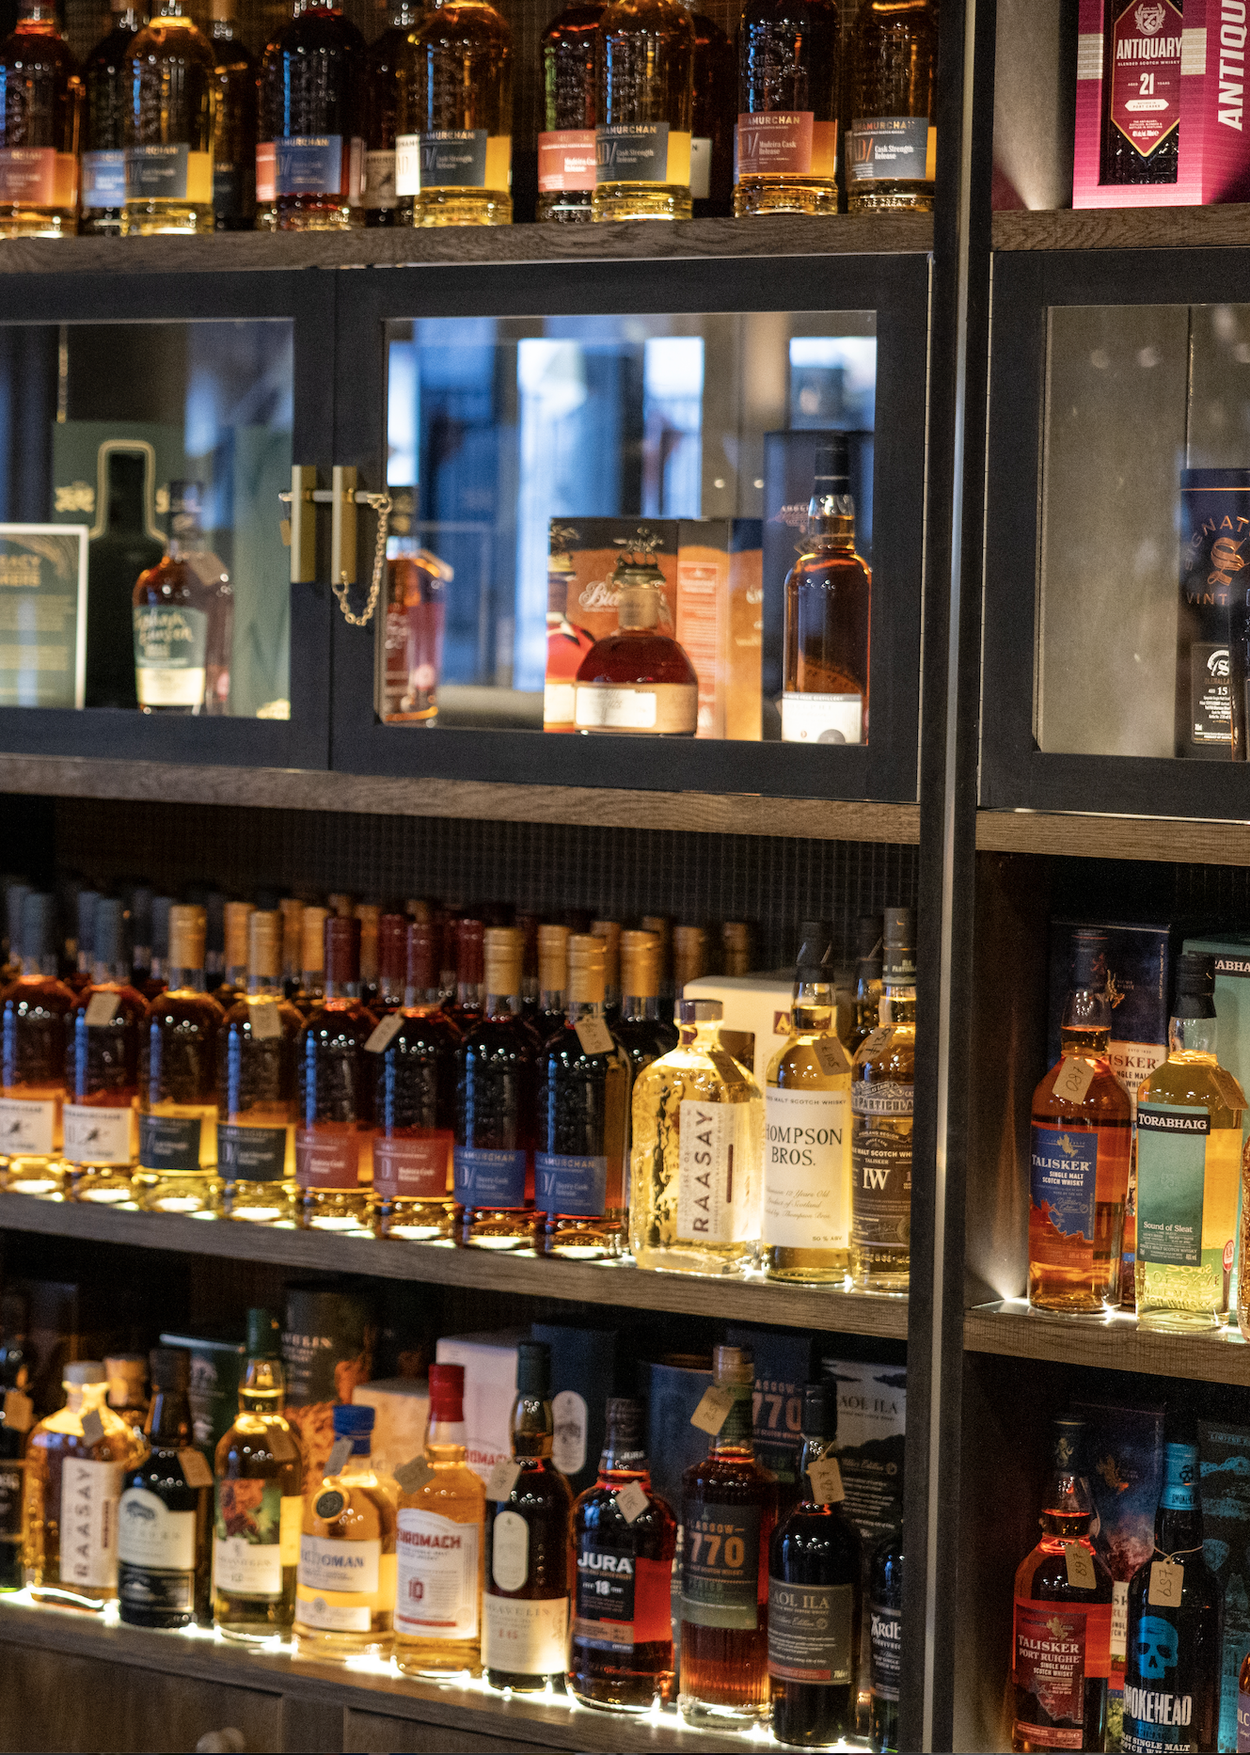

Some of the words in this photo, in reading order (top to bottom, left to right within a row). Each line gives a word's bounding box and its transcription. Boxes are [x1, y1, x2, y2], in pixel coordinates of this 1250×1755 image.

[1116, 37, 1182, 60] ANTIQUARY
[1217, 0, 1248, 132] ANTIQU
[1139, 73, 1154, 95] 21
[874, 144, 886, 153] Cask
[887, 145, 914, 155] Strength
[1184, 514, 1250, 571] SIGNAT
[1186, 591, 1228, 606] VINT
[1217, 686, 1228, 695] 15
[858, 1096, 914, 1112] PARTICULA
[1137, 1112, 1208, 1131] TORABHAIG
[771, 1146, 816, 1167] BROS.
[871, 1150, 897, 1158] SCOTCH
[1032, 1154, 1088, 1172] TALISKER
[692, 1110, 713, 1233] RAASAY
[1049, 1170, 1067, 1179] SINGLE
[1042, 1177, 1061, 1185] SCOTCH
[1061, 1179, 1084, 1187] WHISKY
[1143, 1220, 1164, 1231] Sound
[1165, 1223, 1173, 1232] of
[1174, 1224, 1193, 1233] Sleat
[74, 1467, 91, 1578] RAASAY
[577, 1551, 634, 1574] JURA
[408, 1577, 426, 1602] 10
[595, 1580, 610, 1596] 18
[803, 1595, 829, 1609] ILA
[1018, 1634, 1079, 1654] TALISKER
[1019, 1648, 1039, 1660] PORT
[1040, 1652, 1080, 1664] RUIGHE
[1033, 1667, 1052, 1676] SCOTCH
[1052, 1670, 1073, 1678] WHISKY
[1040, 1661, 1059, 1670] SINGLE
[1132, 1737, 1162, 1750] SINGLE
[1164, 1743, 1190, 1752] MALT
